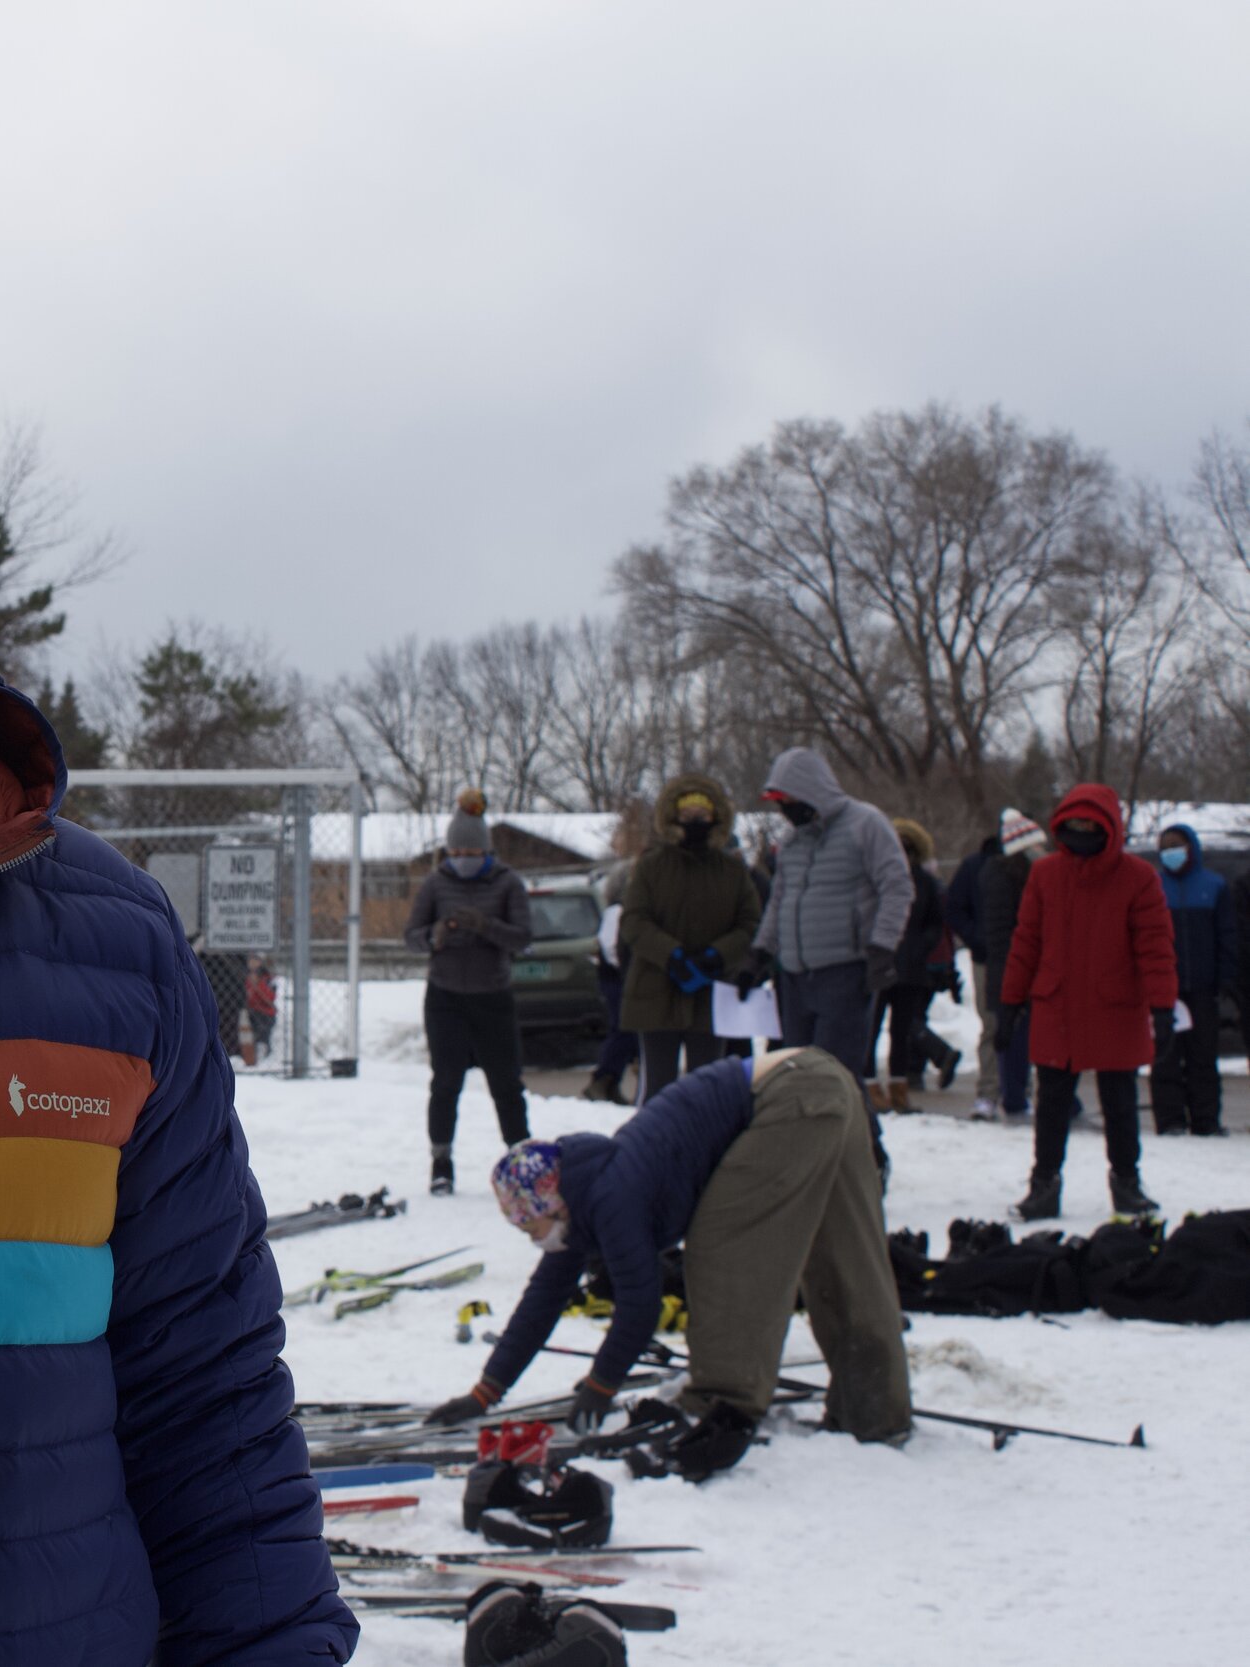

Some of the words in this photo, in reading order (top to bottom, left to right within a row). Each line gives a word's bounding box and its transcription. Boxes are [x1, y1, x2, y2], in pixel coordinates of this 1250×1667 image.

[230, 854, 255, 875] NO
[211, 881, 274, 900] DUMPING
[27, 1091, 111, 1119] cotopaxi
